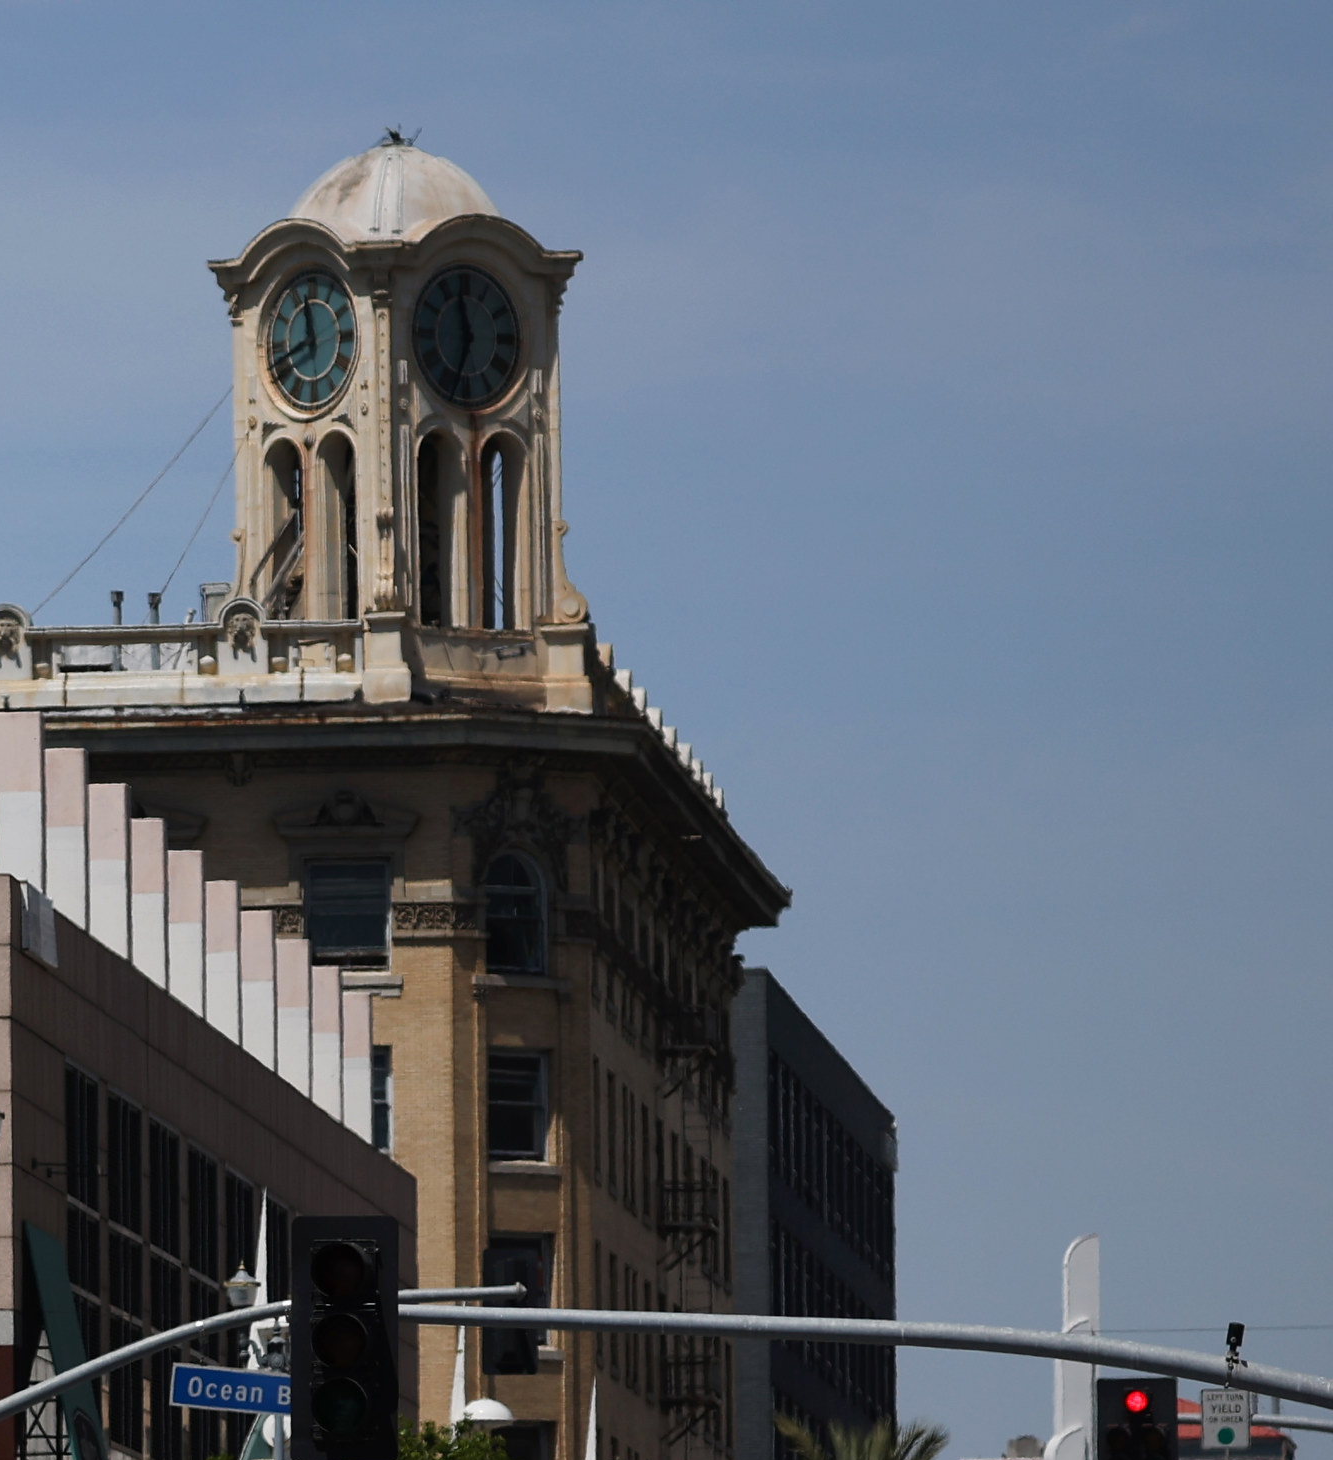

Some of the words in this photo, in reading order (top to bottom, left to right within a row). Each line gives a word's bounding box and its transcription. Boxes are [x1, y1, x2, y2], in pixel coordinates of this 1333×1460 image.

[187, 1375, 263, 1404] Ocean
[1226, 1393, 1244, 1401] TURN
[1211, 1403, 1242, 1413] YIELD
